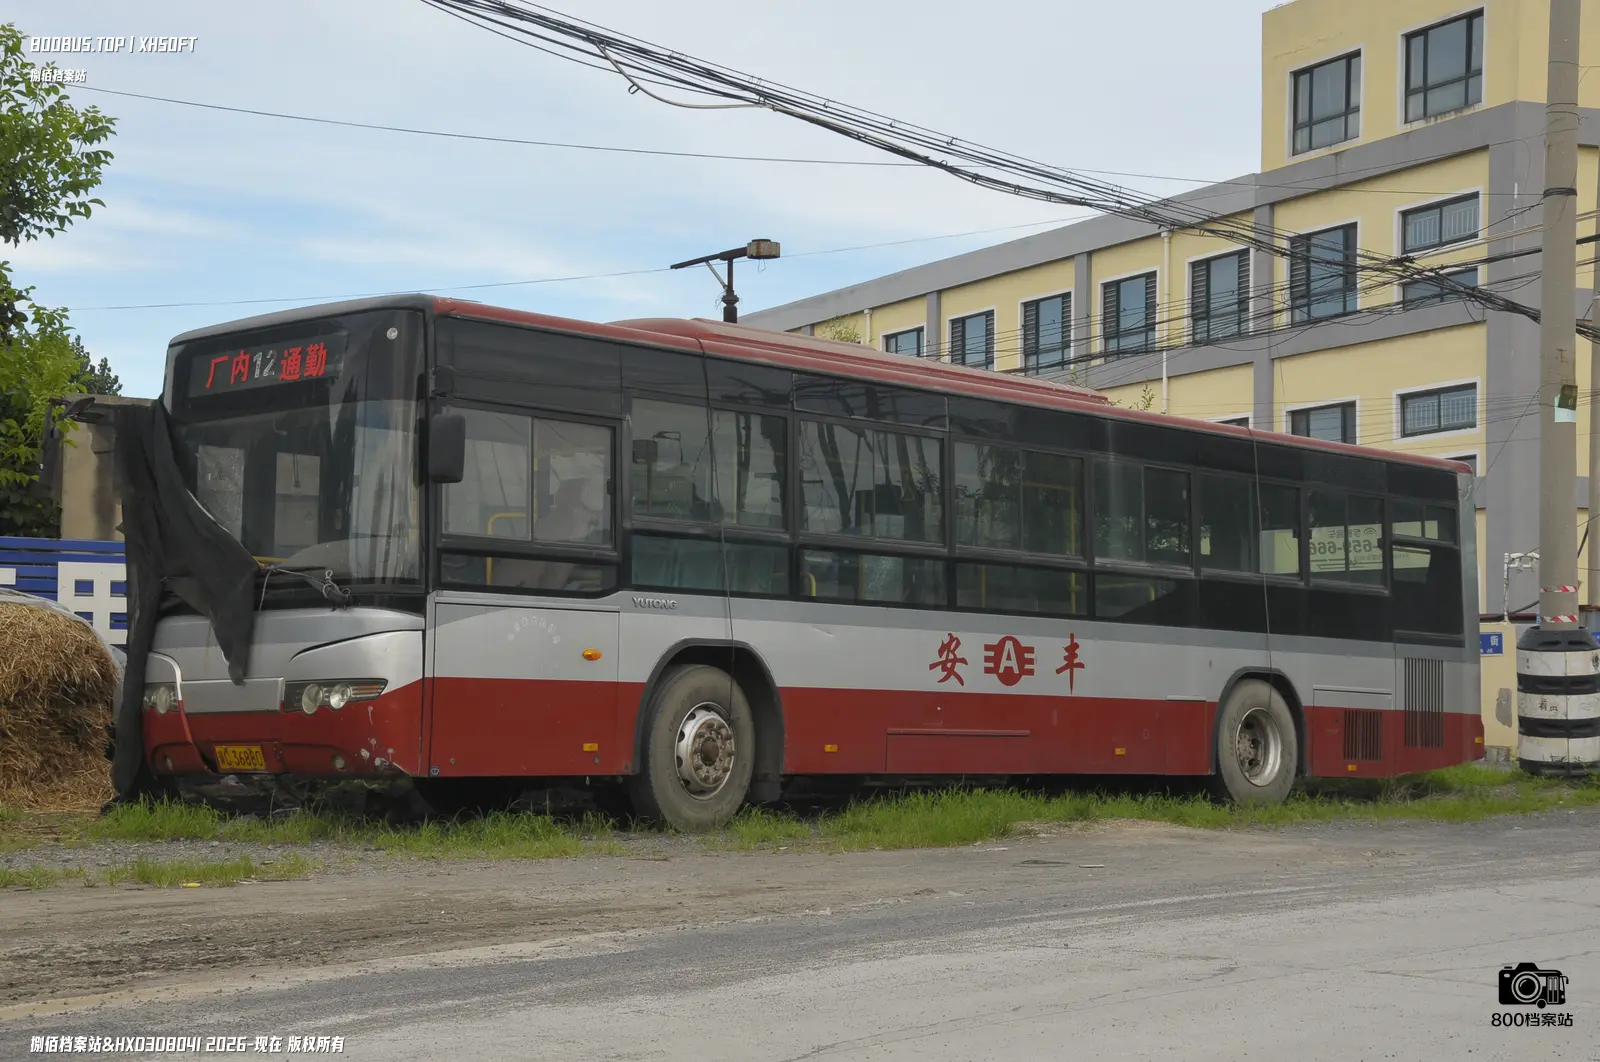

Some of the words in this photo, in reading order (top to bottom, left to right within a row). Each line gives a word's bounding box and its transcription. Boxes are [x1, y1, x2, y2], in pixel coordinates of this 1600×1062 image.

[632, 597, 678, 609] YUTONG
[928, 632, 969, 687] 安
[1055, 632, 1086, 696] 丰
